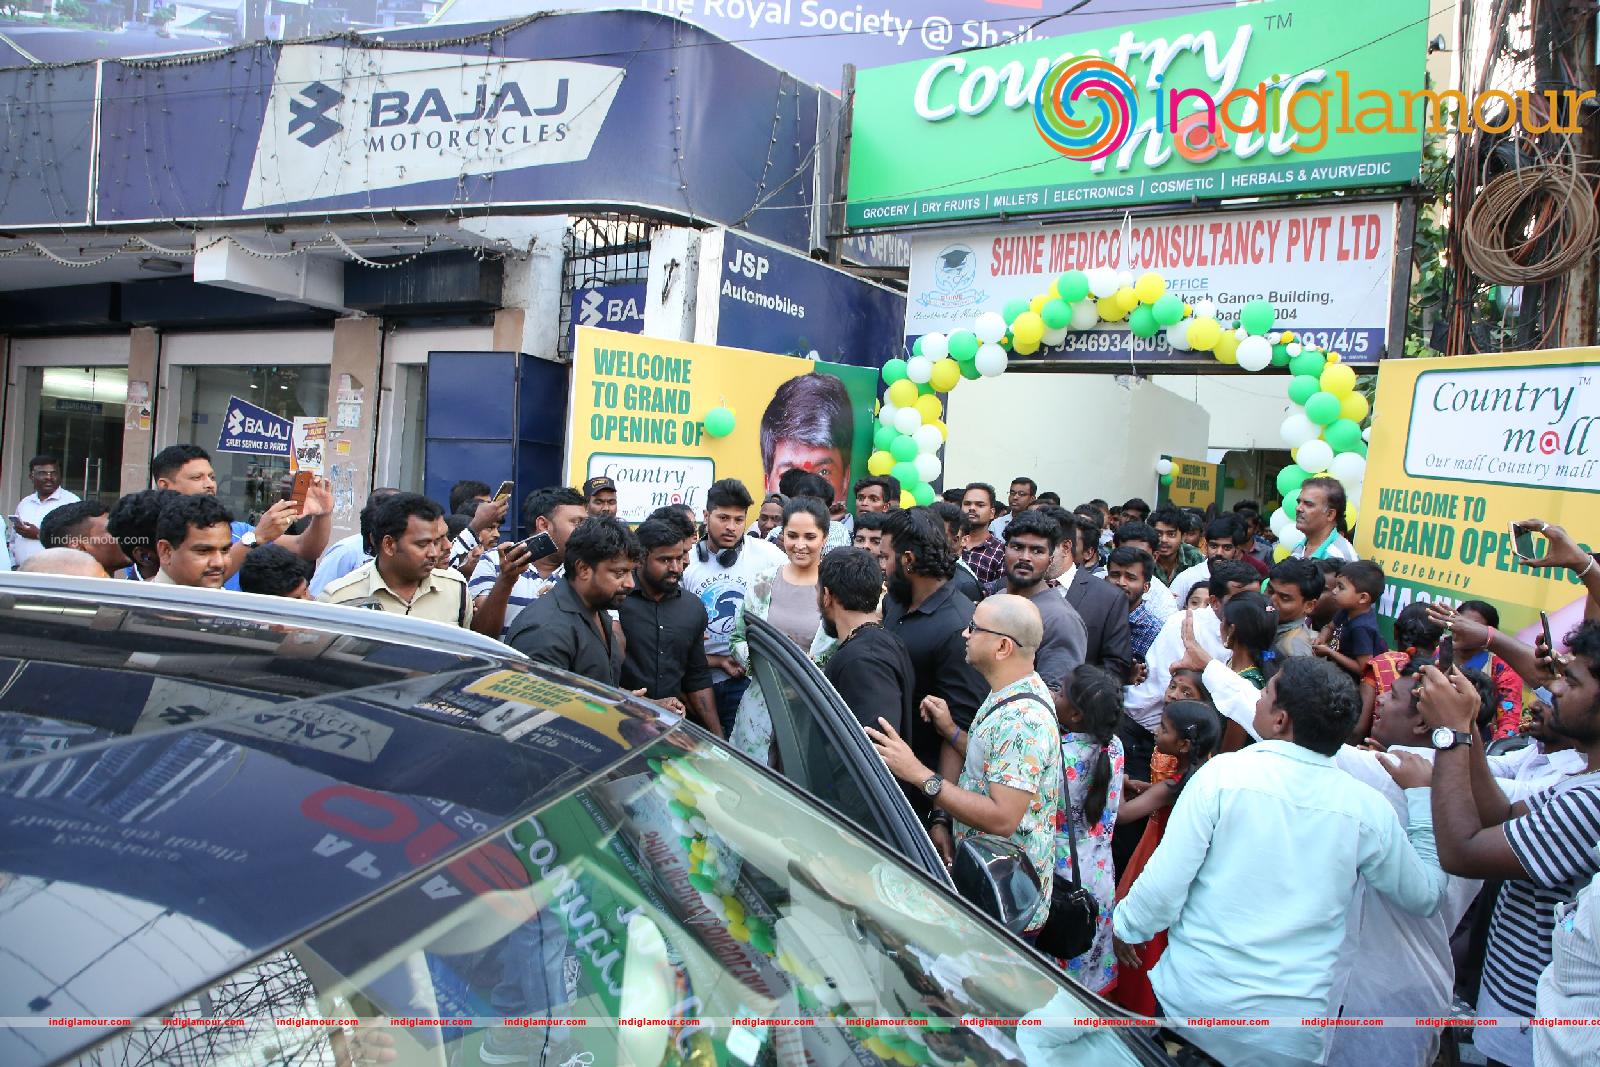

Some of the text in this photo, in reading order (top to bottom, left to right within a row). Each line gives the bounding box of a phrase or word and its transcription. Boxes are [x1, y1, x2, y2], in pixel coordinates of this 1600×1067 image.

[703, 0, 791, 28] Royal
[800, 0, 913, 46] Society
[921, 16, 953, 50] @
[1264, 12, 1292, 30] TM
[914, 24, 1254, 122] Coutry
[370, 78, 569, 128] BAJAJ
[368, 123, 567, 153] MOTORCYCLES
[863, 161, 1392, 219] GROCERY DRY FRUITS MILLETS ELECTRONICS COSMETIC HERBALS & AYURVEDIC
[991, 213, 1381, 277] SHINE MEDICO CONSULTANCY PVT LTD
[728, 249, 770, 281] JSP
[721, 279, 805, 319] Automobiles
[1268, 290, 1334, 305] Building,
[593, 347, 692, 385] WELCOME
[591, 381, 691, 415] TO GRAND
[1432, 376, 1592, 425] Country TM
[242, 439, 263, 450] SERVICE
[244, 416, 291, 441] BAJAJ
[590, 413, 705, 447] OPENING OF
[1503, 415, 1600, 456] m@ll
[603, 463, 686, 491] Country
[1425, 453, 1599, 481] Our mall Country mall
[1378, 487, 1487, 523] WELCOME TO
[1373, 515, 1456, 561] GRAND
[1392, 560, 1471, 589] Celebrity
